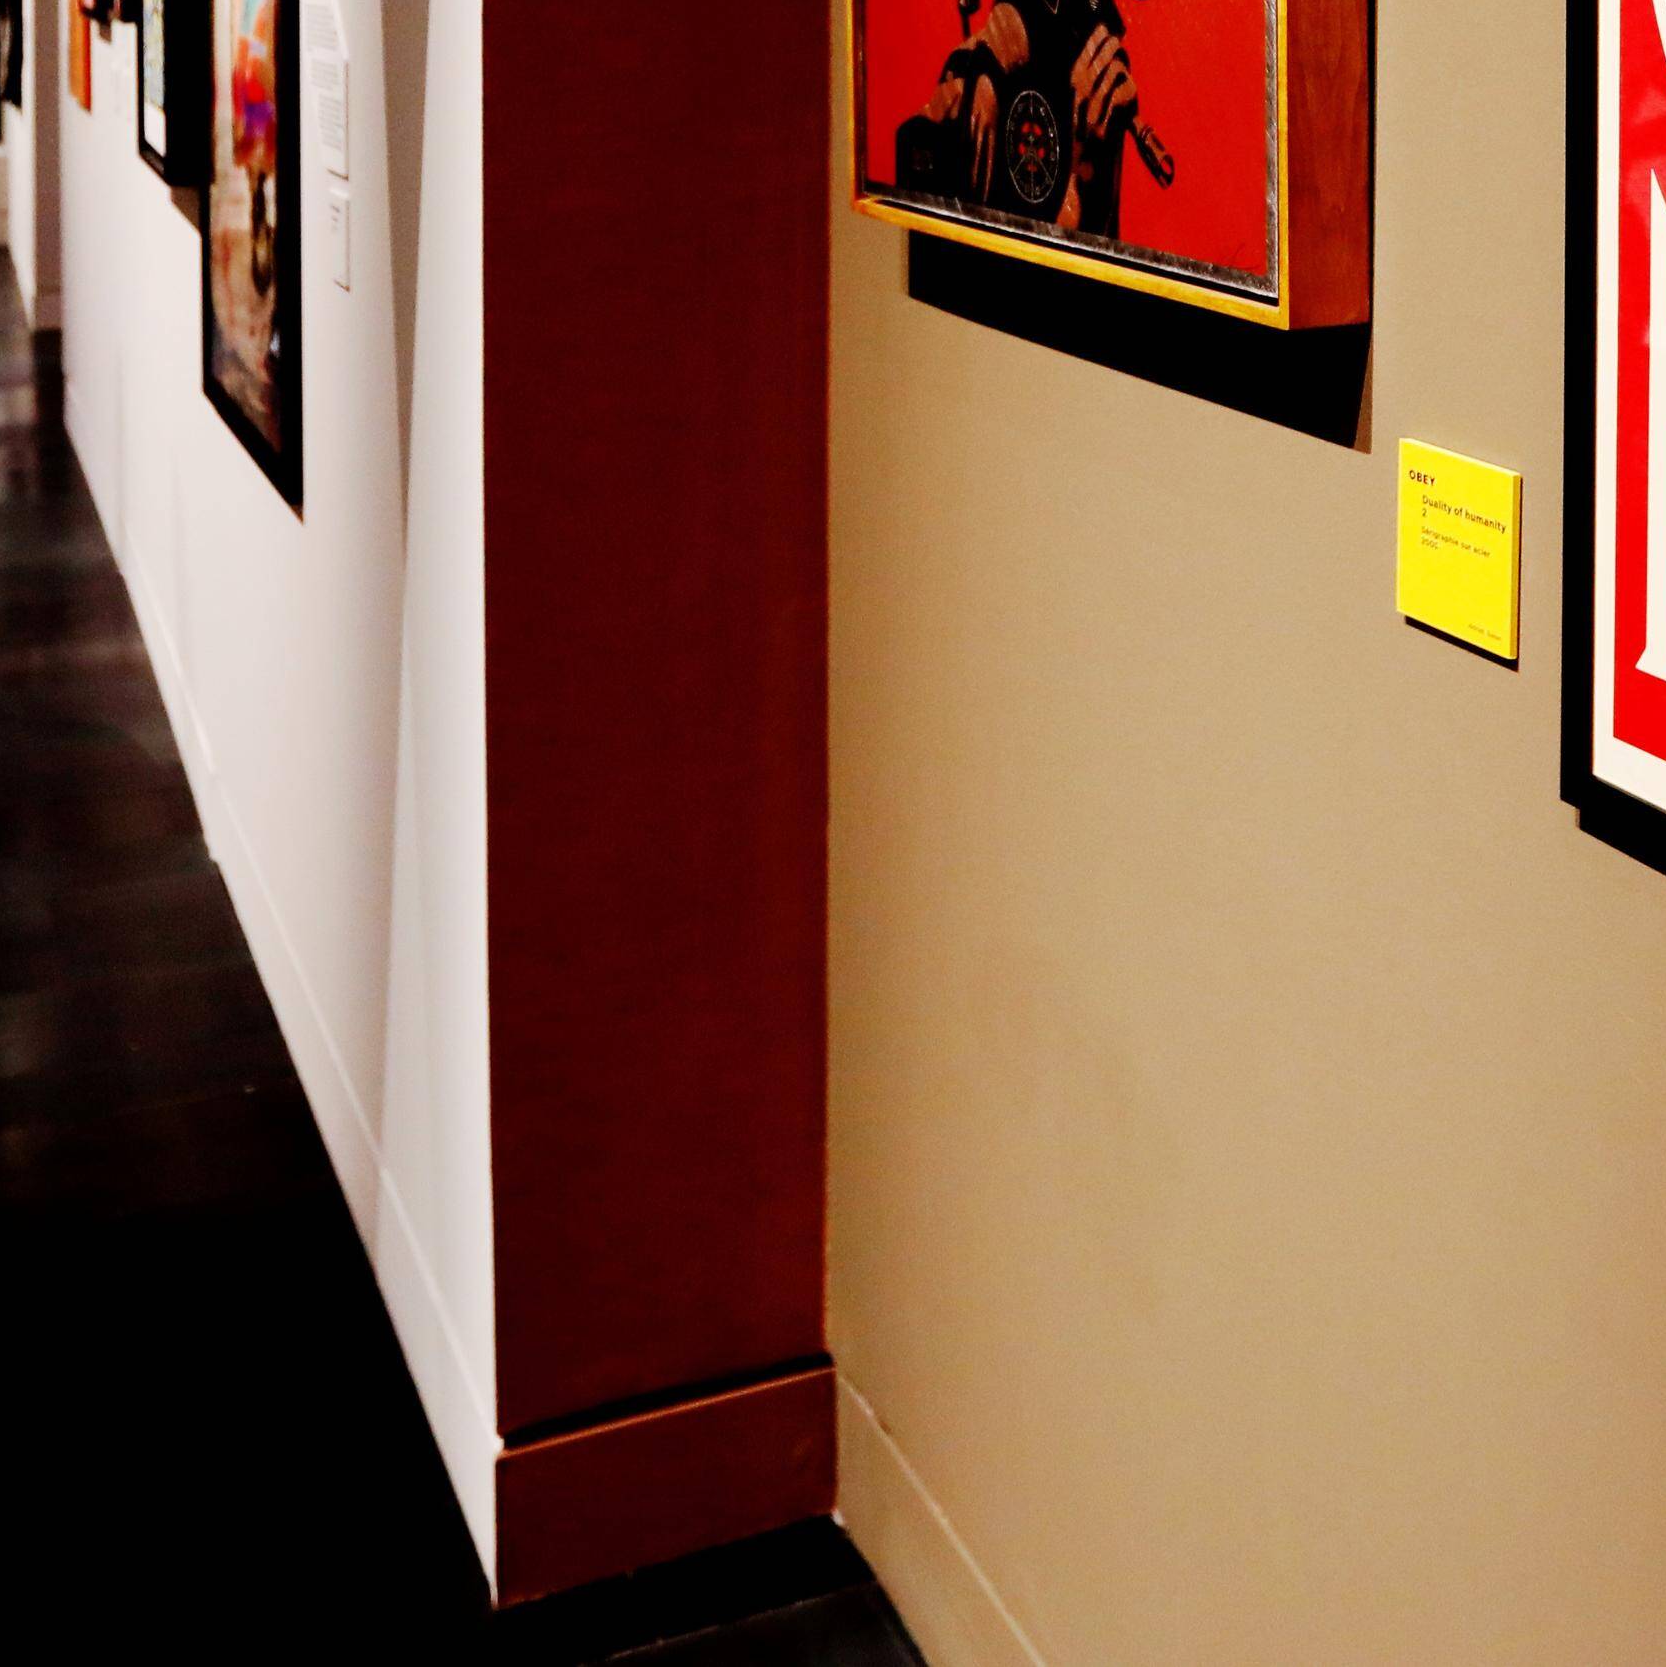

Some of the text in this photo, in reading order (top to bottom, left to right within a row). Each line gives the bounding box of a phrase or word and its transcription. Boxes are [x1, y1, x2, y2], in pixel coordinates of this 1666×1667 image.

[1409, 469, 1436, 486] OBEY
[1421, 508, 1428, 517] 2
[1422, 494, 1507, 535] Duality of humanity
